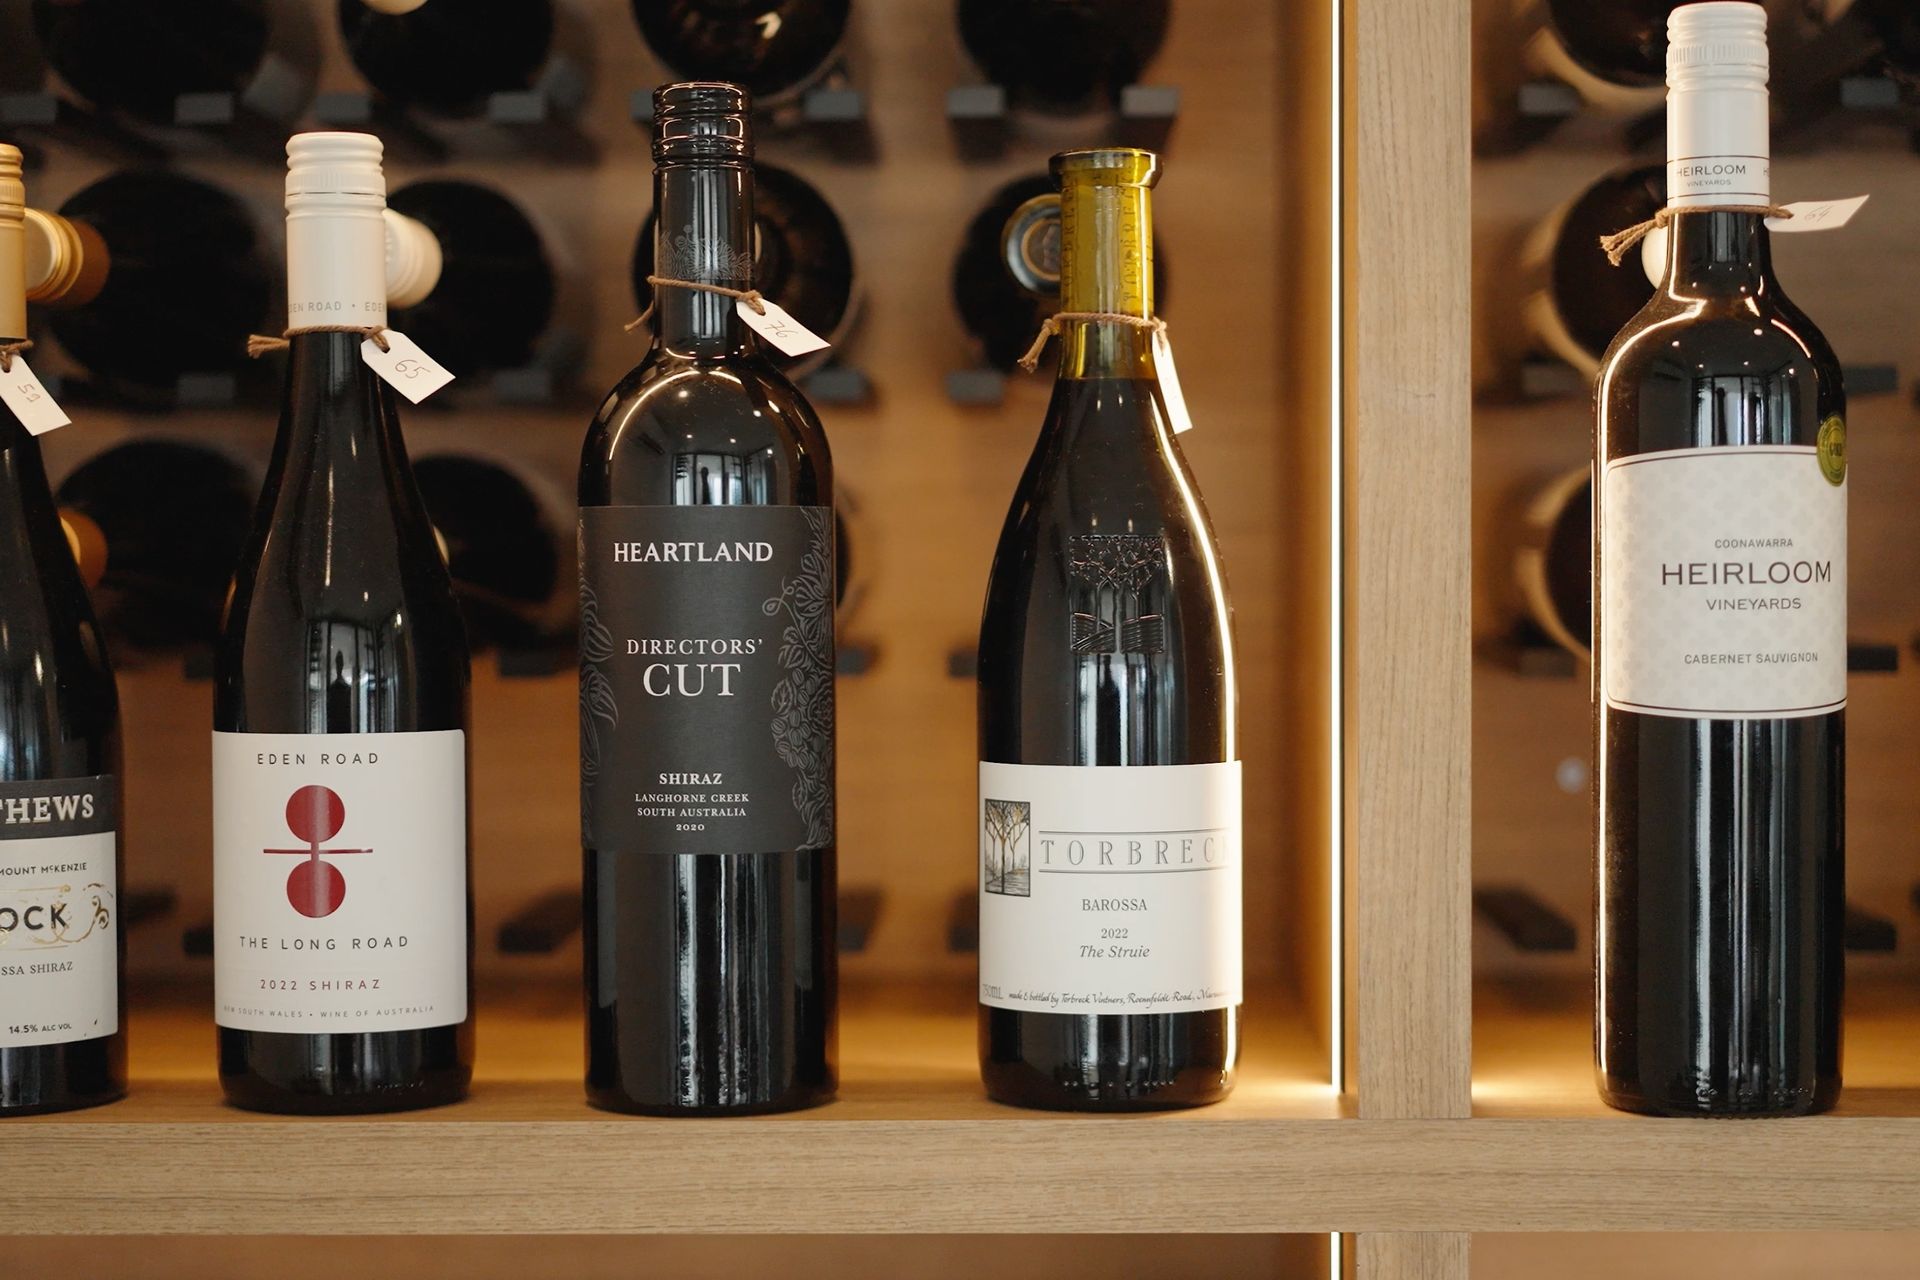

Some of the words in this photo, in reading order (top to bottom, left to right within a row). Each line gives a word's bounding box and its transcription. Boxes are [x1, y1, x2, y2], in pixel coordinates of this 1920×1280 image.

[1677, 165, 1746, 177] HEIRLOOM
[1687, 179, 1732, 187] VINEYARDS
[308, 301, 342, 312] ROAD
[764, 320, 798, 339] 76
[394, 359, 431, 379] 65
[1714, 539, 1793, 549] COONAWARRA
[614, 542, 773, 562] HEARTLAND
[1662, 561, 1831, 586] HEIRLOOM
[1706, 598, 1802, 610] VINEYARDS
[1684, 654, 1751, 664] CABERNET
[1756, 653, 1818, 663] SAUVIGNON
[642, 663, 741, 697] CUT
[257, 753, 306, 765] EDEN
[321, 752, 379, 765] ROAD
[659, 772, 723, 785] SHIRAZ
[635, 793, 707, 803] LANGHORNE
[711, 793, 749, 802] CREEK
[637, 807, 676, 817] SOUTH
[680, 808, 747, 817] AUSTRALIA
[676, 823, 705, 831] 2020
[1082, 899, 1148, 912] BAROSSA
[1101, 928, 1128, 939] 2022
[240, 936, 268, 949] THE
[281, 938, 336, 950] LONG
[352, 936, 408, 949] ROAD
[1080, 945, 1104, 958] The
[1108, 945, 1150, 958] Struie
[30, 961, 73, 974] SHIRAZ
[260, 979, 298, 990] 2022
[310, 979, 381, 990] SHIRAZ
[1061, 993, 1090, 1004] Torbreck
[238, 1007, 264, 1016] SOUTH
[269, 1010, 303, 1018] WALES
[320, 1010, 348, 1018] WINE
[376, 1005, 434, 1016] AUSTRALIA
[9, 1025, 38, 1034] 14.5%
